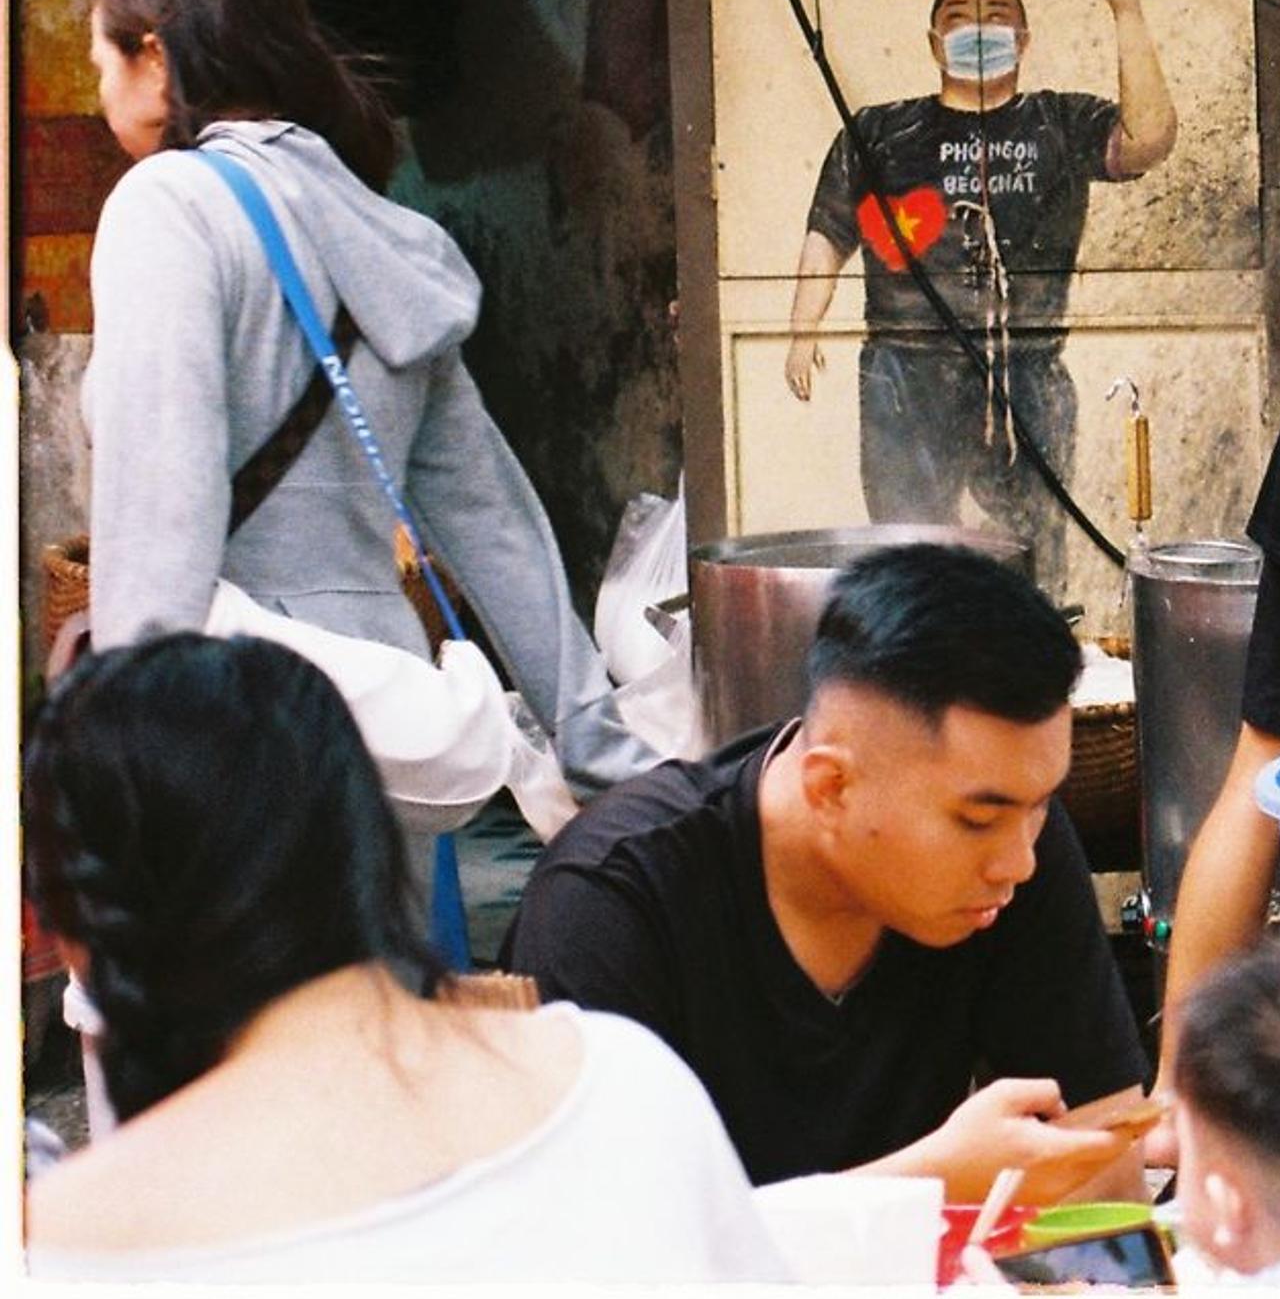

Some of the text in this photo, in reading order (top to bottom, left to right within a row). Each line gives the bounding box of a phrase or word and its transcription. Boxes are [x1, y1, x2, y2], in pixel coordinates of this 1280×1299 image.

[940, 131, 1039, 163] PHỞ NGON
[943, 162, 1036, 195] BÉO CHẤT
